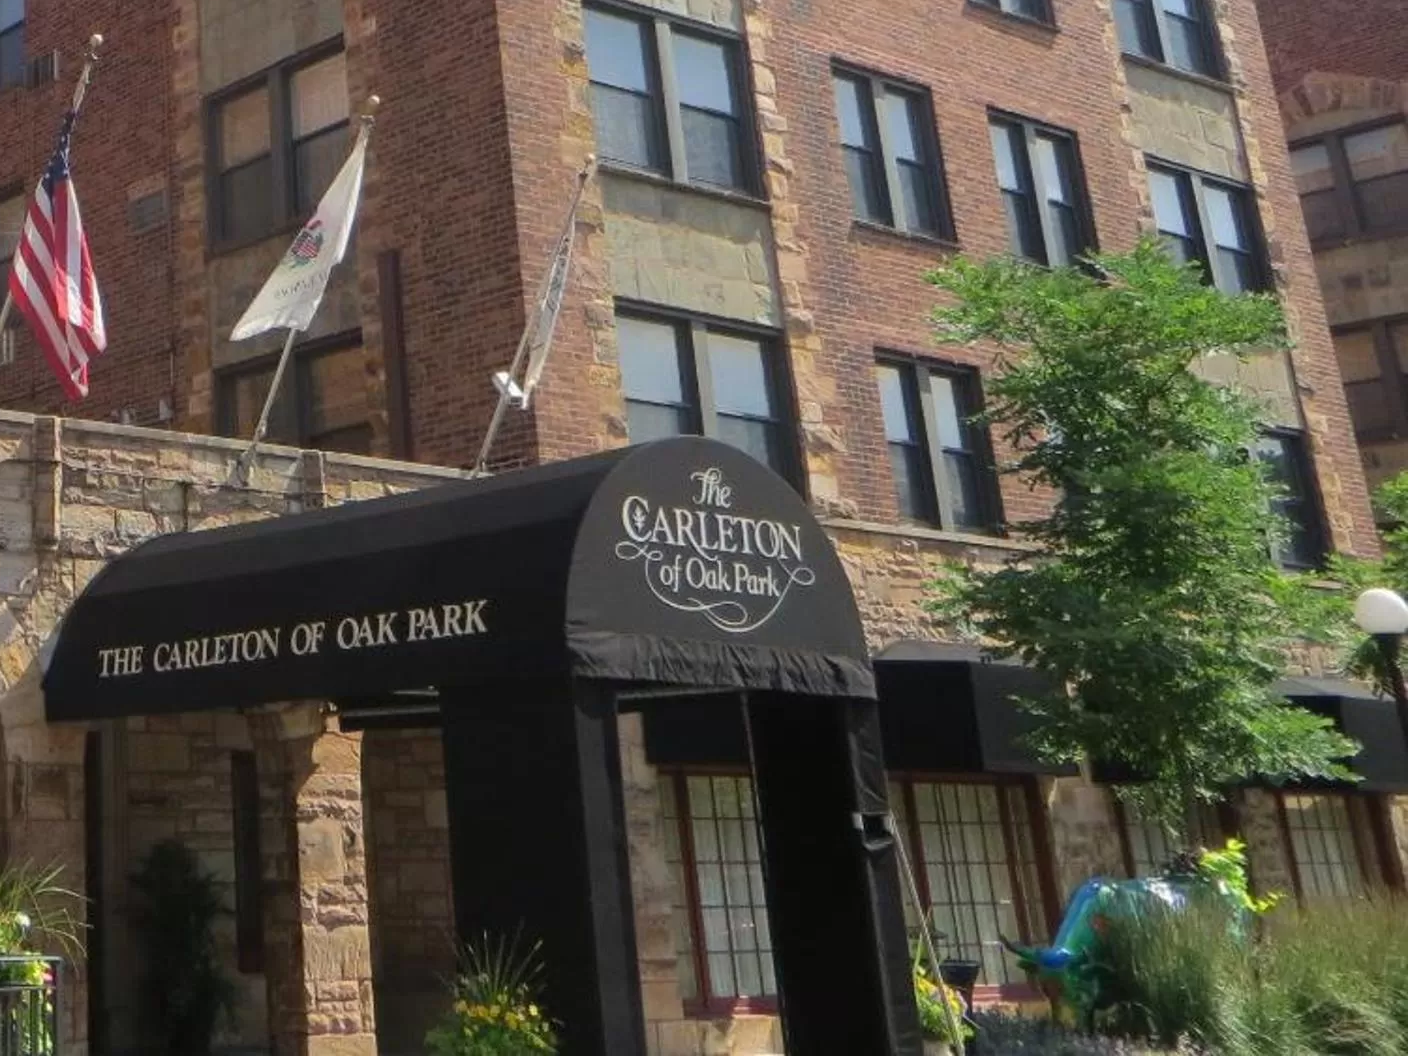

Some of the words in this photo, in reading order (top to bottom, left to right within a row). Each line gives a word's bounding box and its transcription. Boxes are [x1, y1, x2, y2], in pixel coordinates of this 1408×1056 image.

[691, 467, 733, 508] The
[622, 495, 803, 562] CARLETON
[659, 554, 682, 593] of
[685, 556, 732, 592] Oak
[733, 562, 781, 598] Park
[97, 645, 145, 678] THE
[152, 627, 282, 672] CARLETON
[291, 621, 327, 656] OF
[336, 611, 398, 650] OAK
[405, 599, 489, 642] PARK
